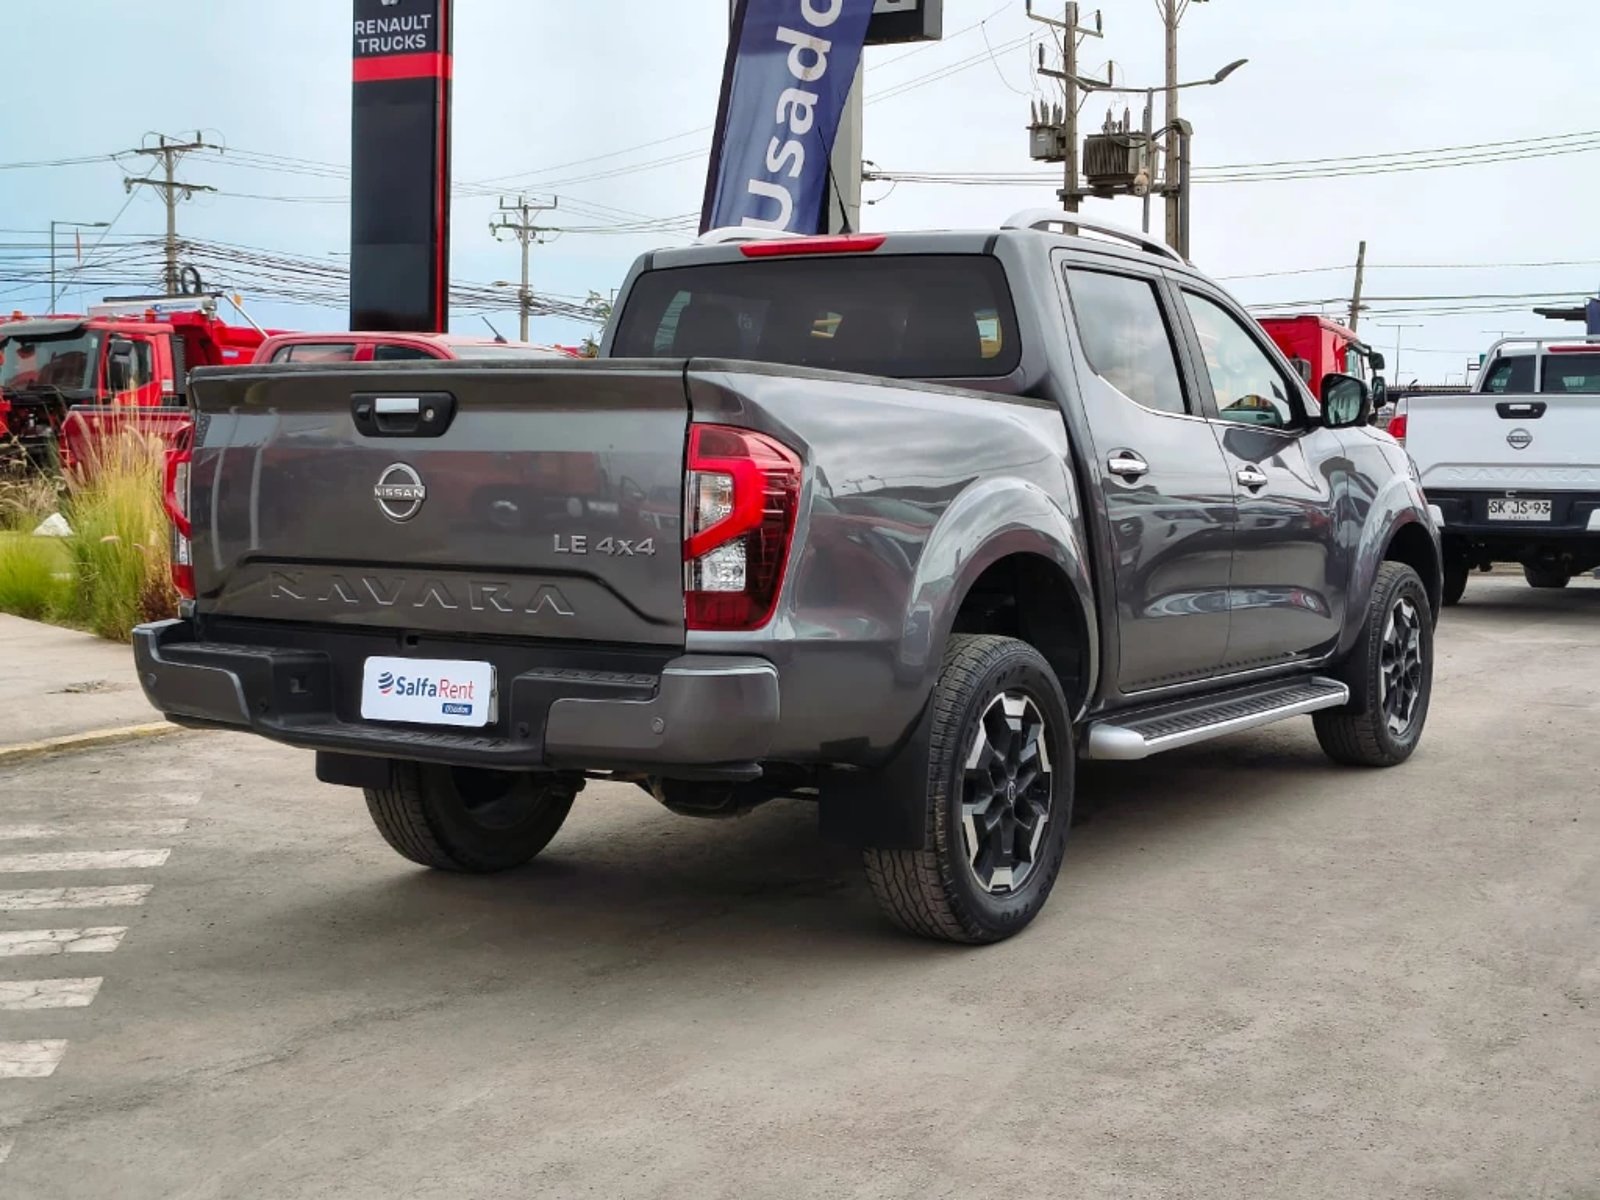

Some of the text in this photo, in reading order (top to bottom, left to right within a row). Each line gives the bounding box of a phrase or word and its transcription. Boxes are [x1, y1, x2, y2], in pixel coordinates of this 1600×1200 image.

[354, 14, 432, 35] RENAULT
[358, 34, 427, 53] TRUCKS
[374, 488, 424, 498] NISSAN
[554, 534, 655, 556] LE 4x4
[270, 570, 575, 616] NAVARA
[395, 675, 475, 700] SalfaRent
